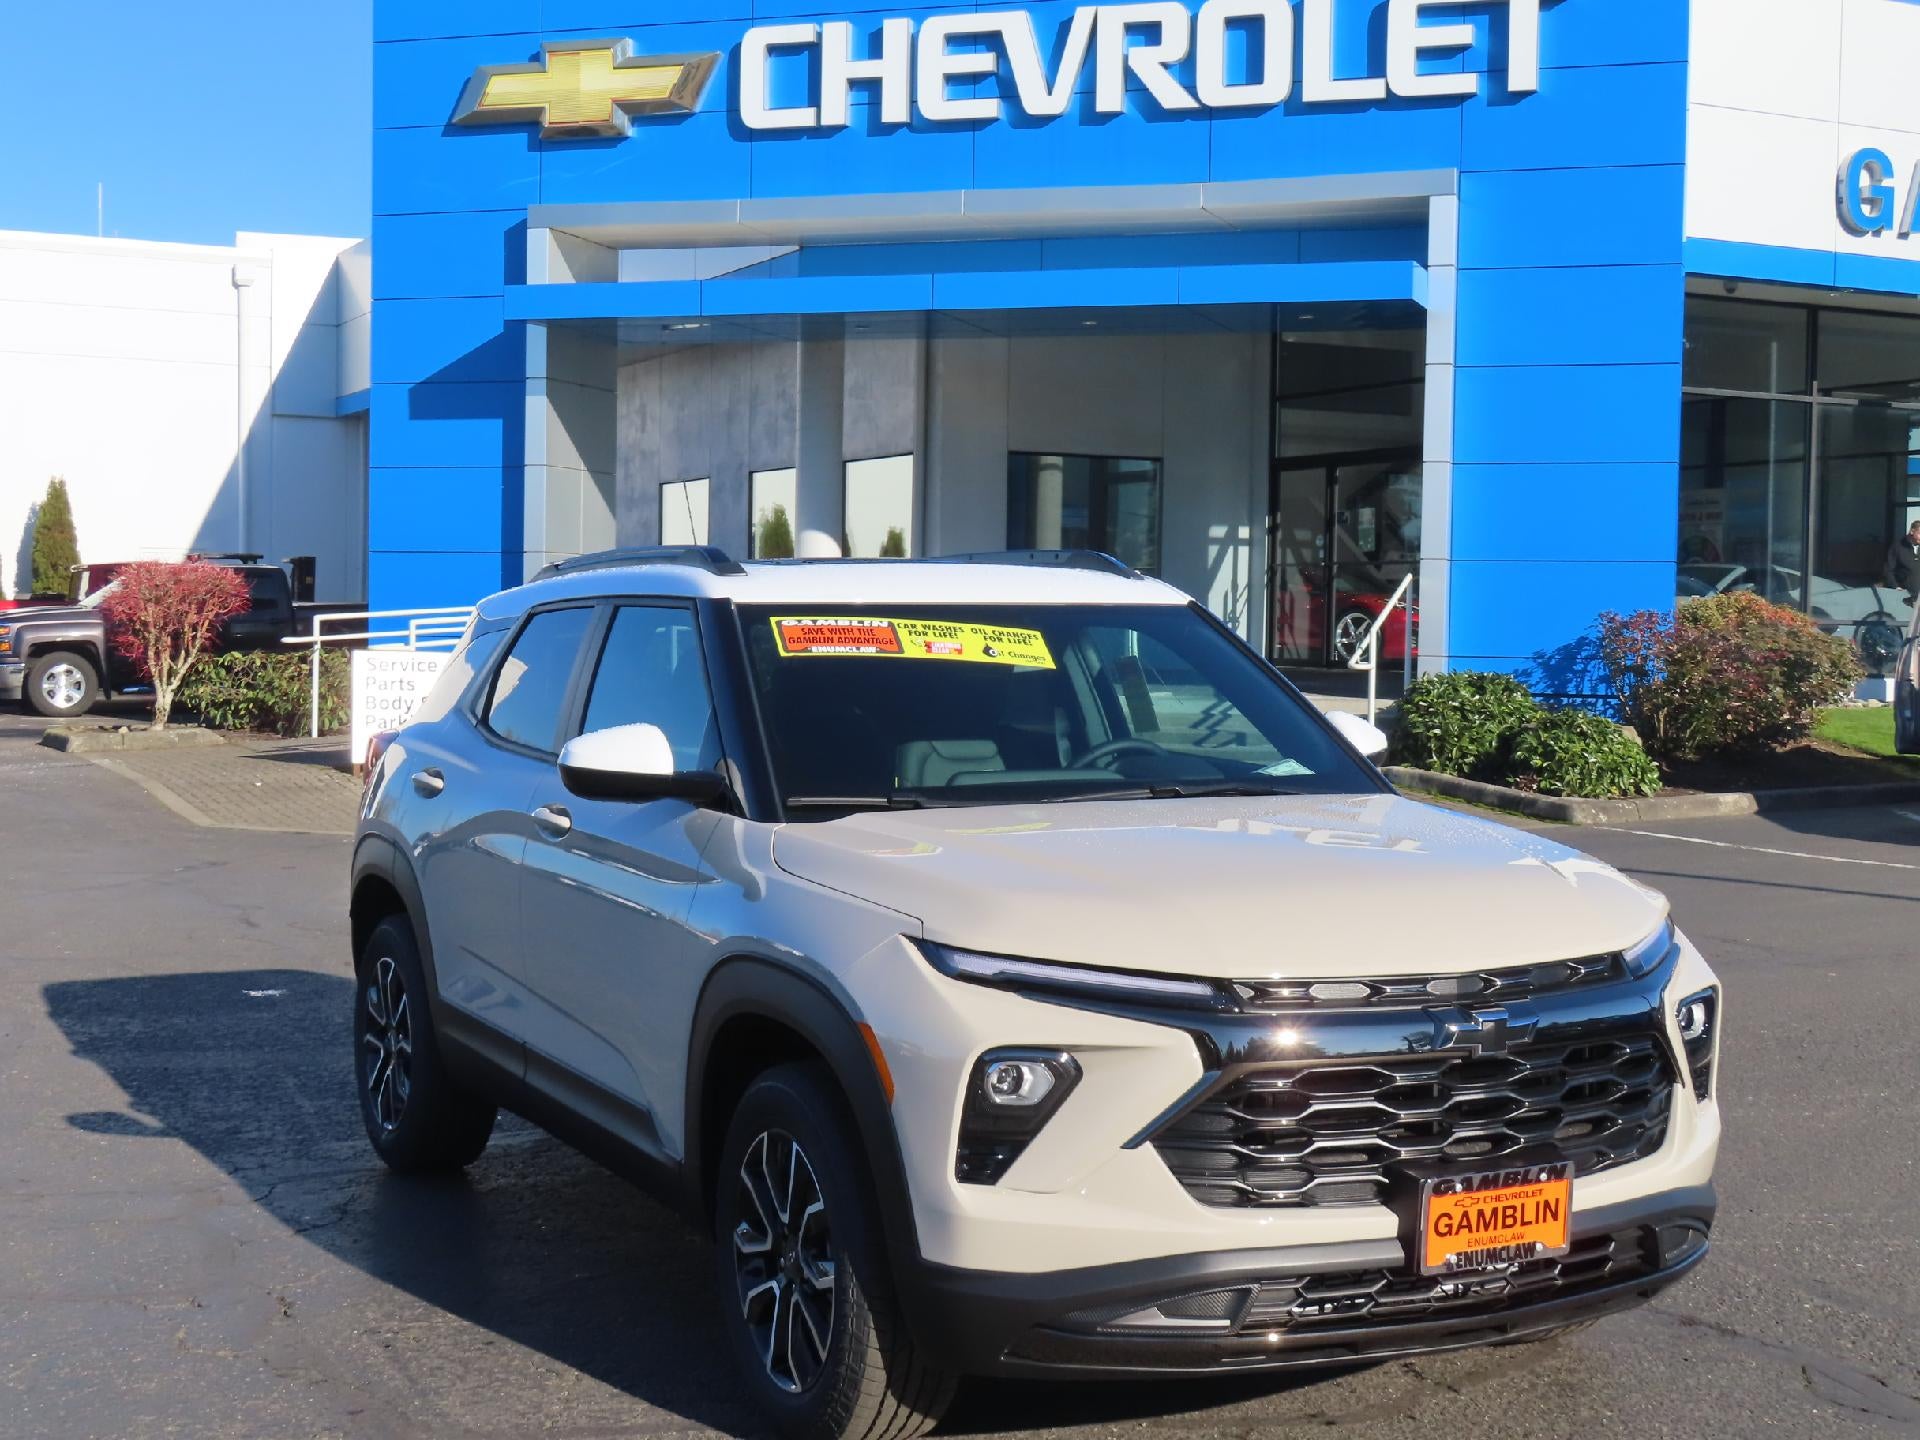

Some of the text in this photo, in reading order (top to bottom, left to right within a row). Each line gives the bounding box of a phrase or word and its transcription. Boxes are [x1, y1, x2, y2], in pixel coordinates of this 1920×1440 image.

[740, 0, 1540, 129] CHEVROLET
[801, 628, 877, 637] SAVE WITH THE
[897, 622, 965, 633] CAR WASHES
[970, 627, 1039, 641] OIL CHANGES
[837, 637, 895, 645] ADVANTAGE
[933, 631, 959, 640] LIFE!
[983, 635, 1033, 646] FOR LIFE!
[367, 658, 438, 672] Service
[366, 676, 415, 691] Parts
[366, 696, 414, 714] Body
[1432, 1163, 1568, 1196] GAMBLIN
[1483, 1189, 1543, 1204] CHEVROLET
[1434, 1198, 1560, 1238] GAMBLIN
[1467, 1232, 1526, 1247] ENUMCLAW
[1456, 1241, 1537, 1270] ENUMCLAW
